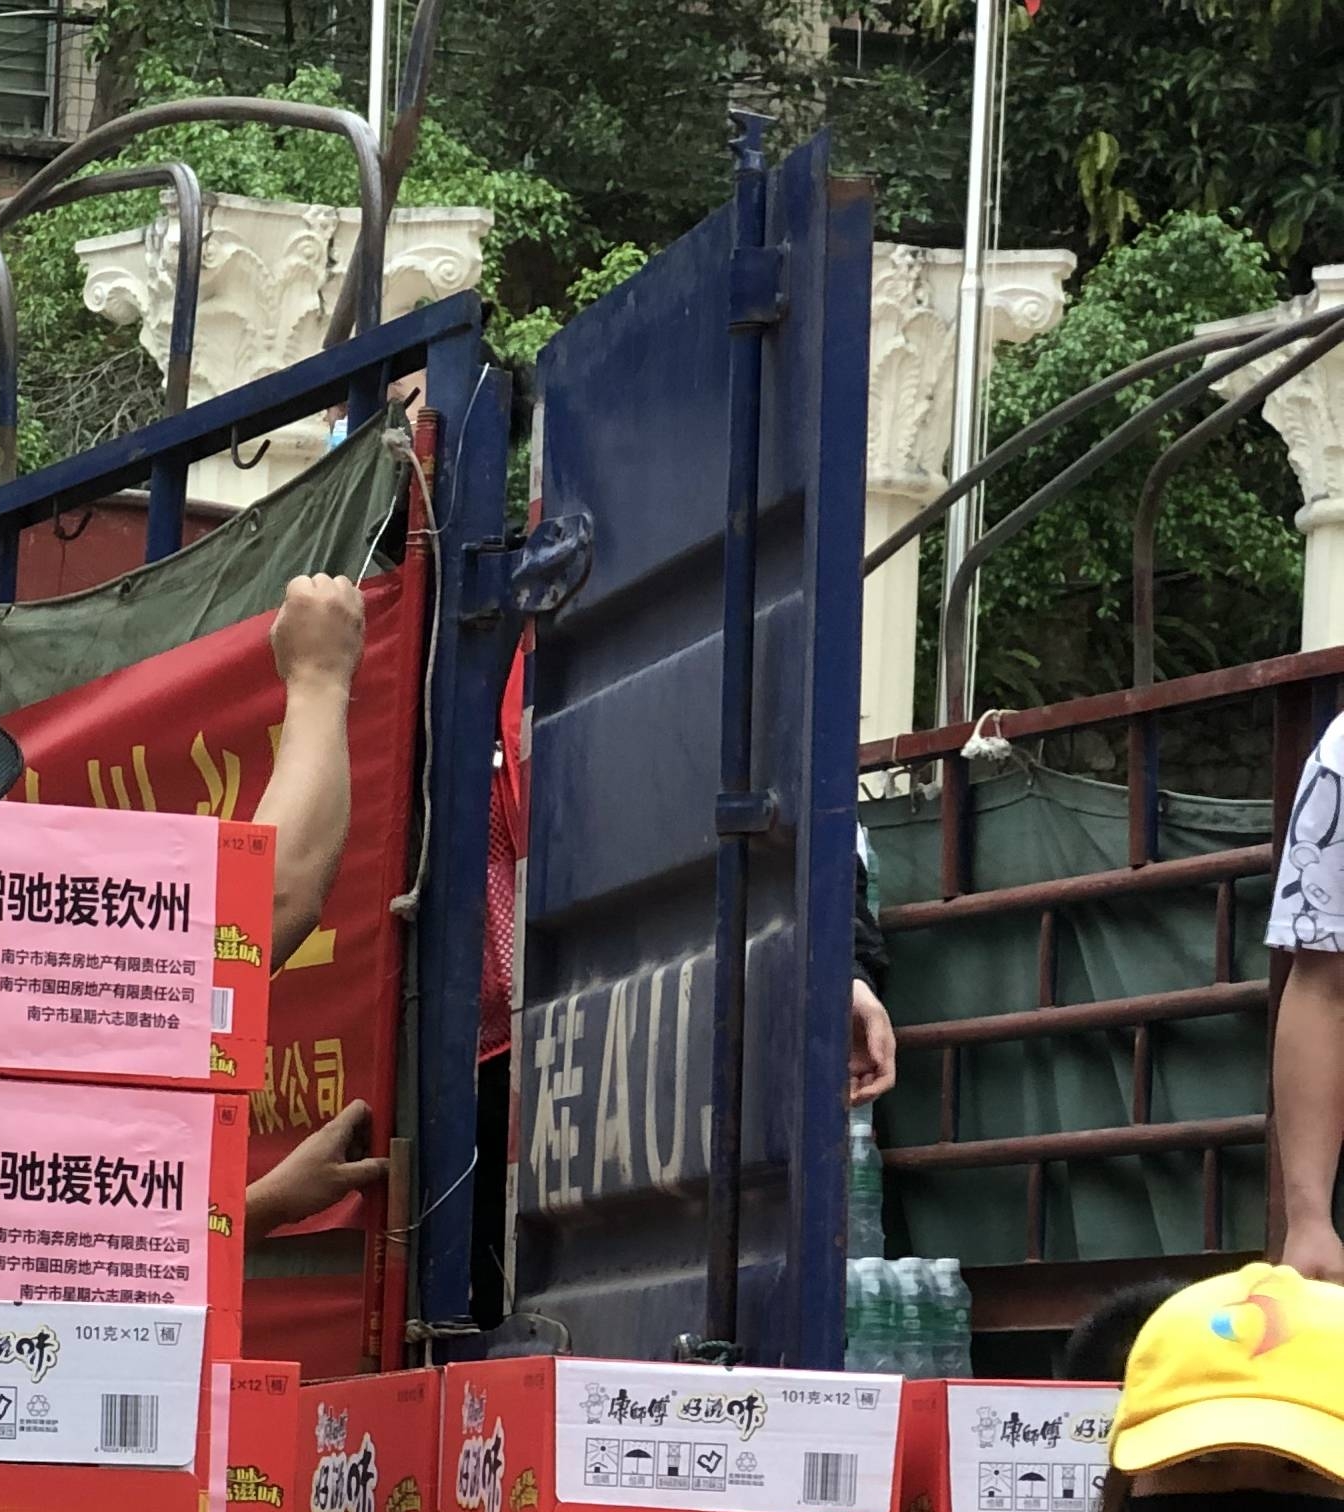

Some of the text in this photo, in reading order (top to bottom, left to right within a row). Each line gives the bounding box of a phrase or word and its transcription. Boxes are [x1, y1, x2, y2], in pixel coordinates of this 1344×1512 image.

[1, 949, 196, 976] 南宁市海奔房地产有限责任公司
[0, 977, 194, 1004] 南宁市国田房地产有限责任公司
[27, 1006, 180, 1030] 南宁市星期六志愿者协会
[529, 958, 713, 1213] 桂AU
[19, 1283, 174, 1304] 南宁市星期六志愿者协会
[75, 1325, 150, 1343] 101克×12
[782, 1389, 851, 1406] 101克×12
